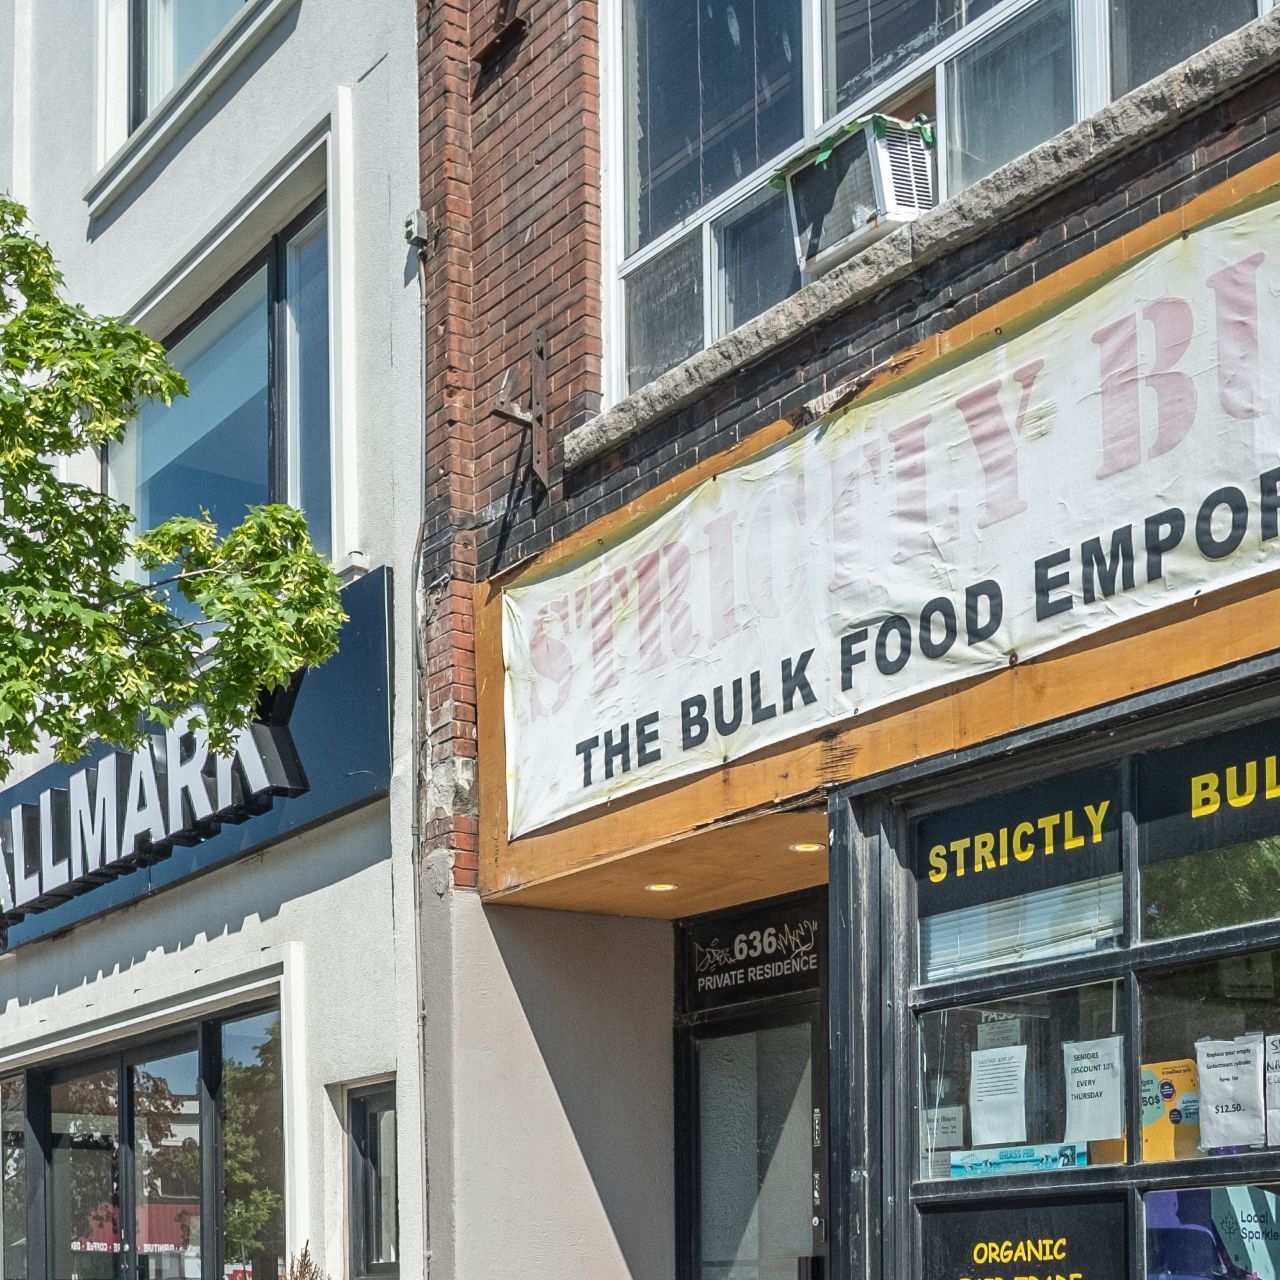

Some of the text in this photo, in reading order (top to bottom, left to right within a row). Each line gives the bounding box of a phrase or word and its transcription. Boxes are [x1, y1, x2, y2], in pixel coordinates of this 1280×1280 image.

[530, 359, 1045, 722] STRICTLY
[576, 711, 663, 788] THE
[680, 648, 818, 751] BULK
[840, 579, 1004, 693] FOOD
[927, 800, 1112, 883] STRICTLY
[733, 928, 778, 961] 636
[697, 969, 746, 992] PRIVATE
[748, 953, 818, 982] RESIDENCE
[1071, 1064, 1101, 1074] DISCOUNT
[1073, 1052, 1099, 1061] SENIORS
[1071, 1091, 1103, 1101] THURSDAY
[1076, 1079, 1096, 1088] EVERY
[1240, 1210, 1268, 1223] Local
[972, 1238, 1066, 1264] ORGANIC
